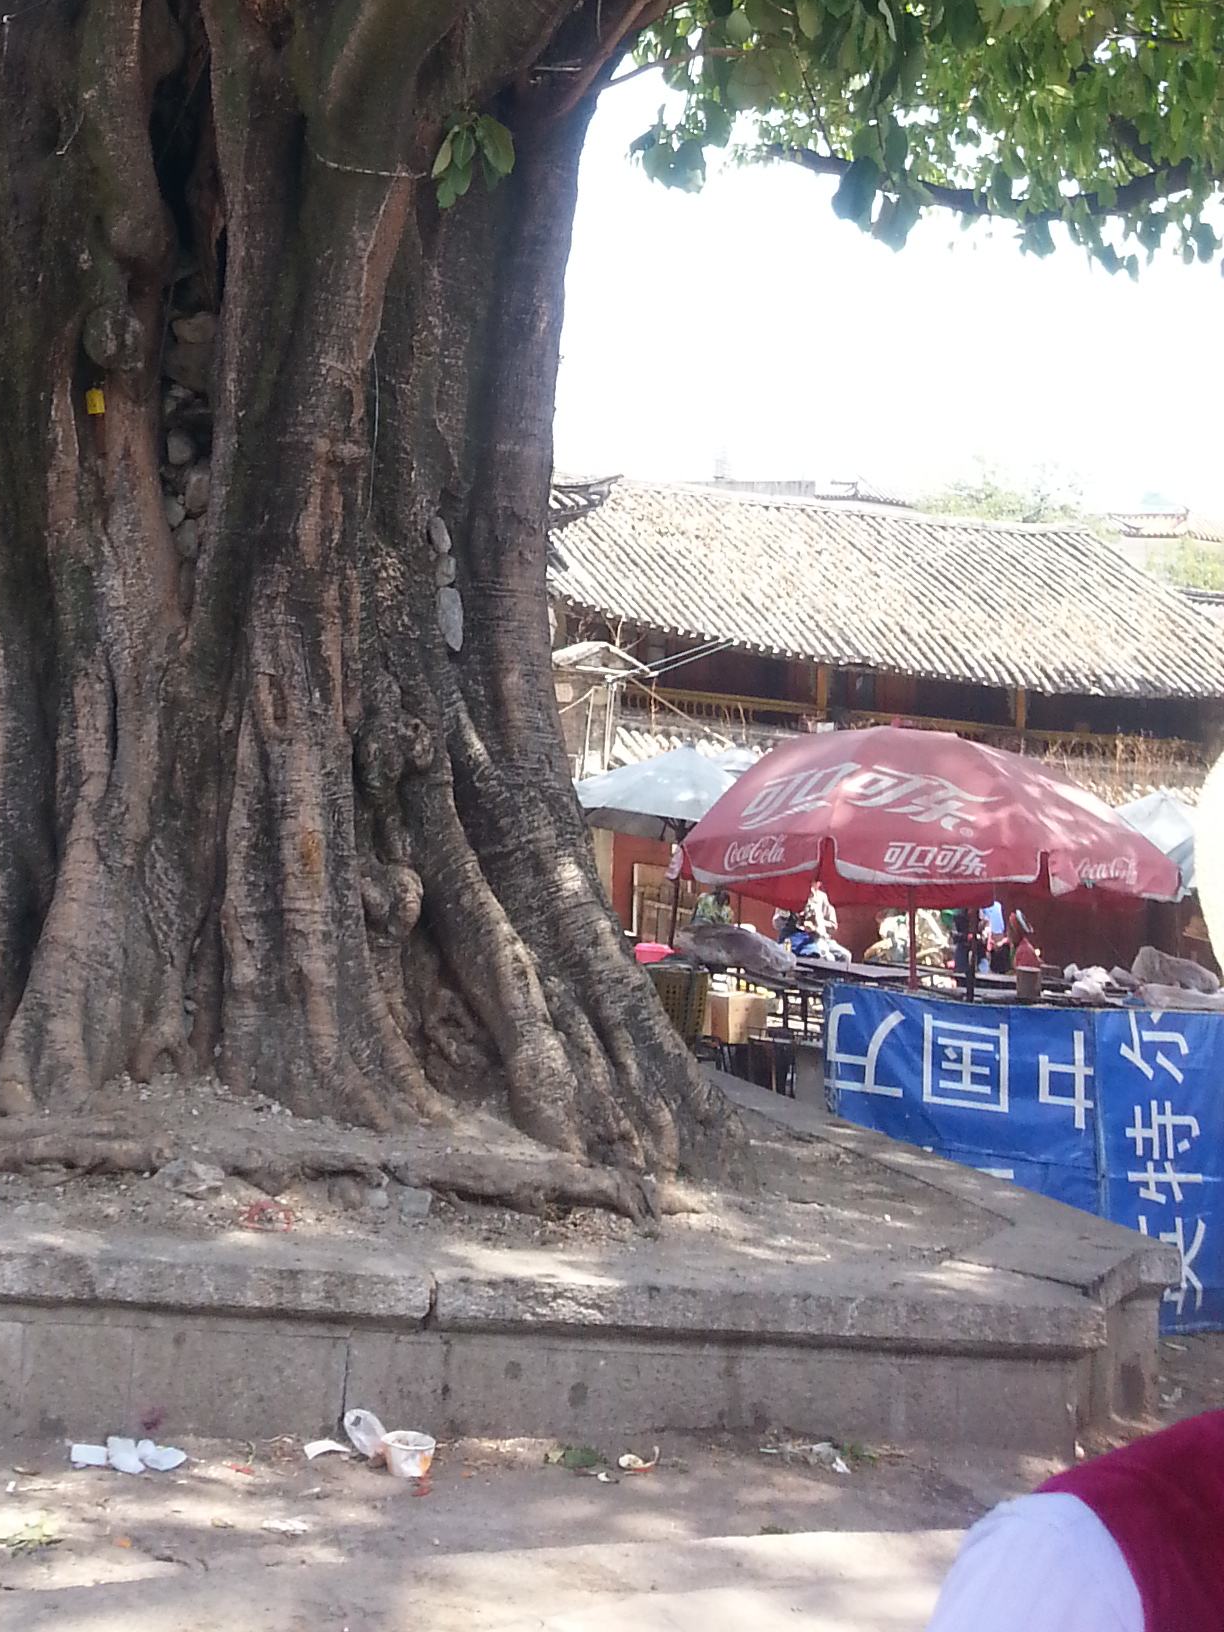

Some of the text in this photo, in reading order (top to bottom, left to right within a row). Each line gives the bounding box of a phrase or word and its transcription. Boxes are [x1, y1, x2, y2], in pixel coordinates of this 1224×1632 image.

[739, 762, 1004, 831] 可口可乐
[884, 841, 993, 877] 可口可乐
